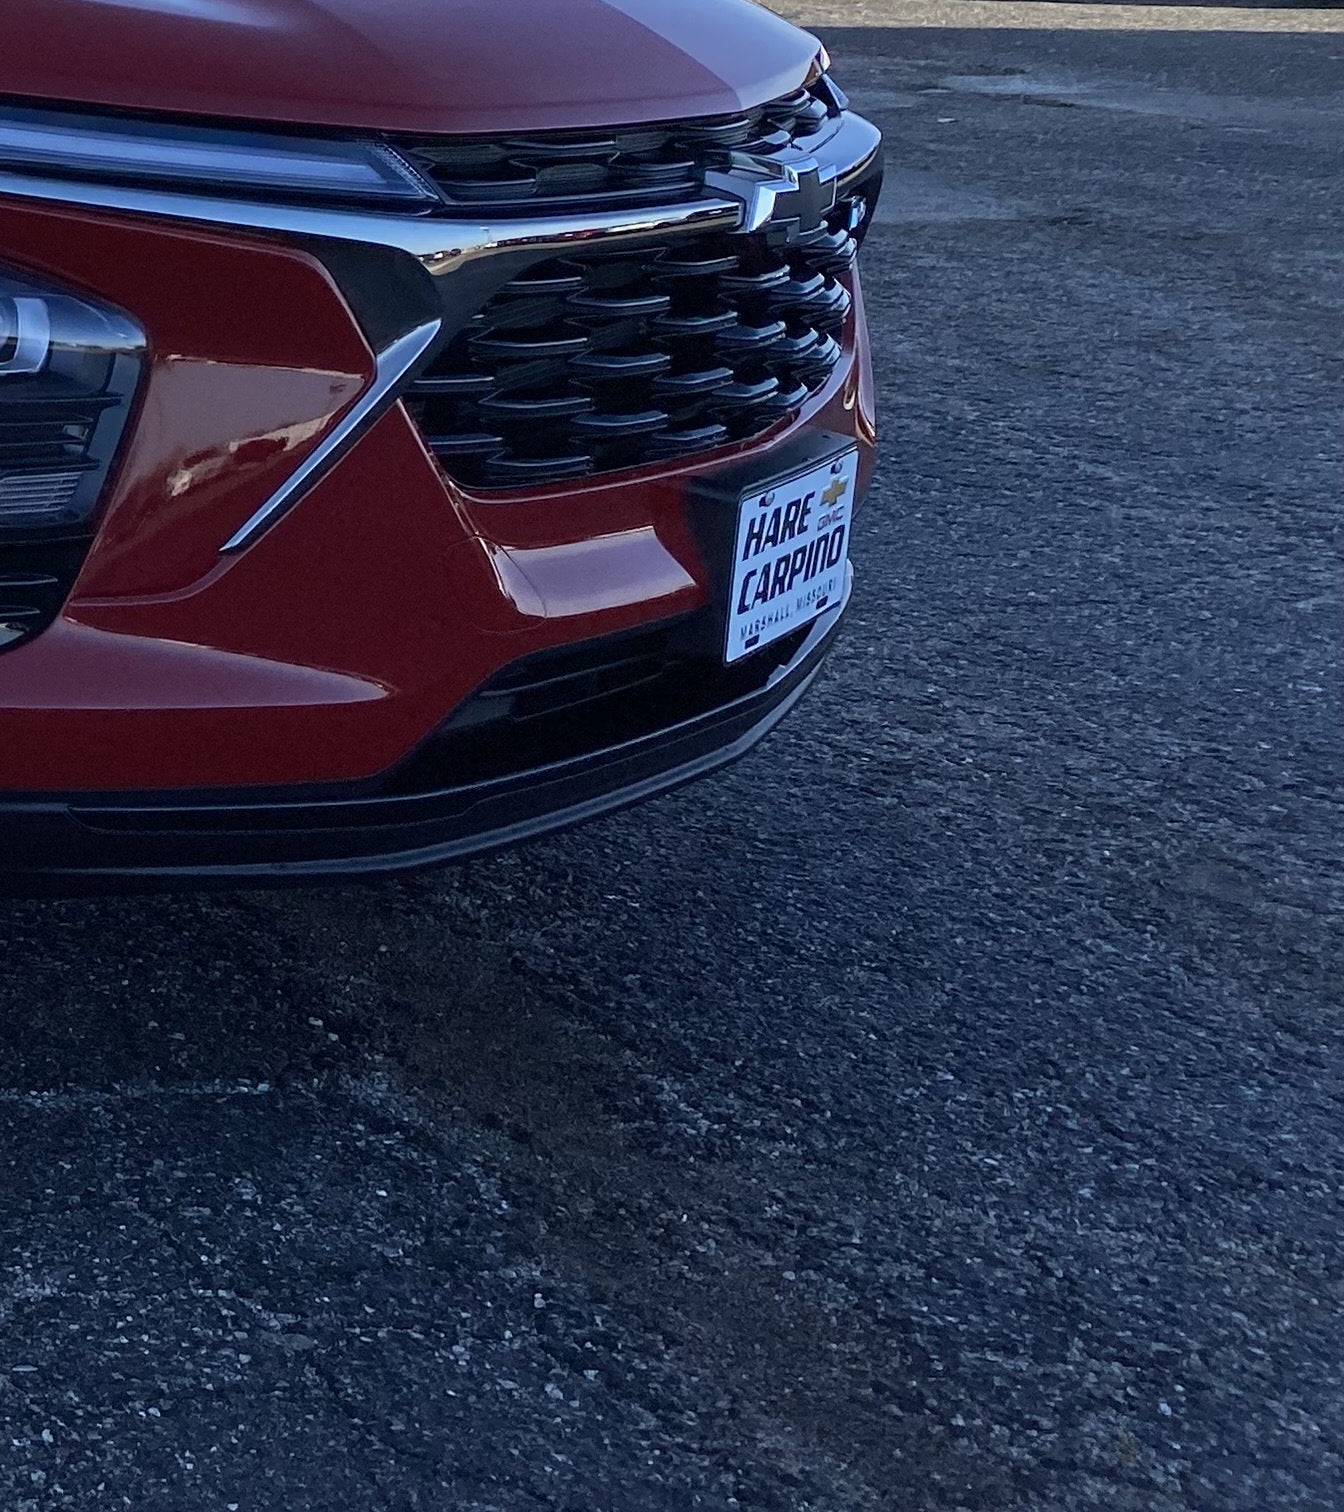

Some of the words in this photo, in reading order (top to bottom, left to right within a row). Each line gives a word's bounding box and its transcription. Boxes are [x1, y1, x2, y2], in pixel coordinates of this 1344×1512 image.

[742, 491, 816, 562] HARE
[817, 505, 846, 532] GMC
[737, 524, 846, 616] CARPINO
[796, 576, 837, 610] MISSOURI
